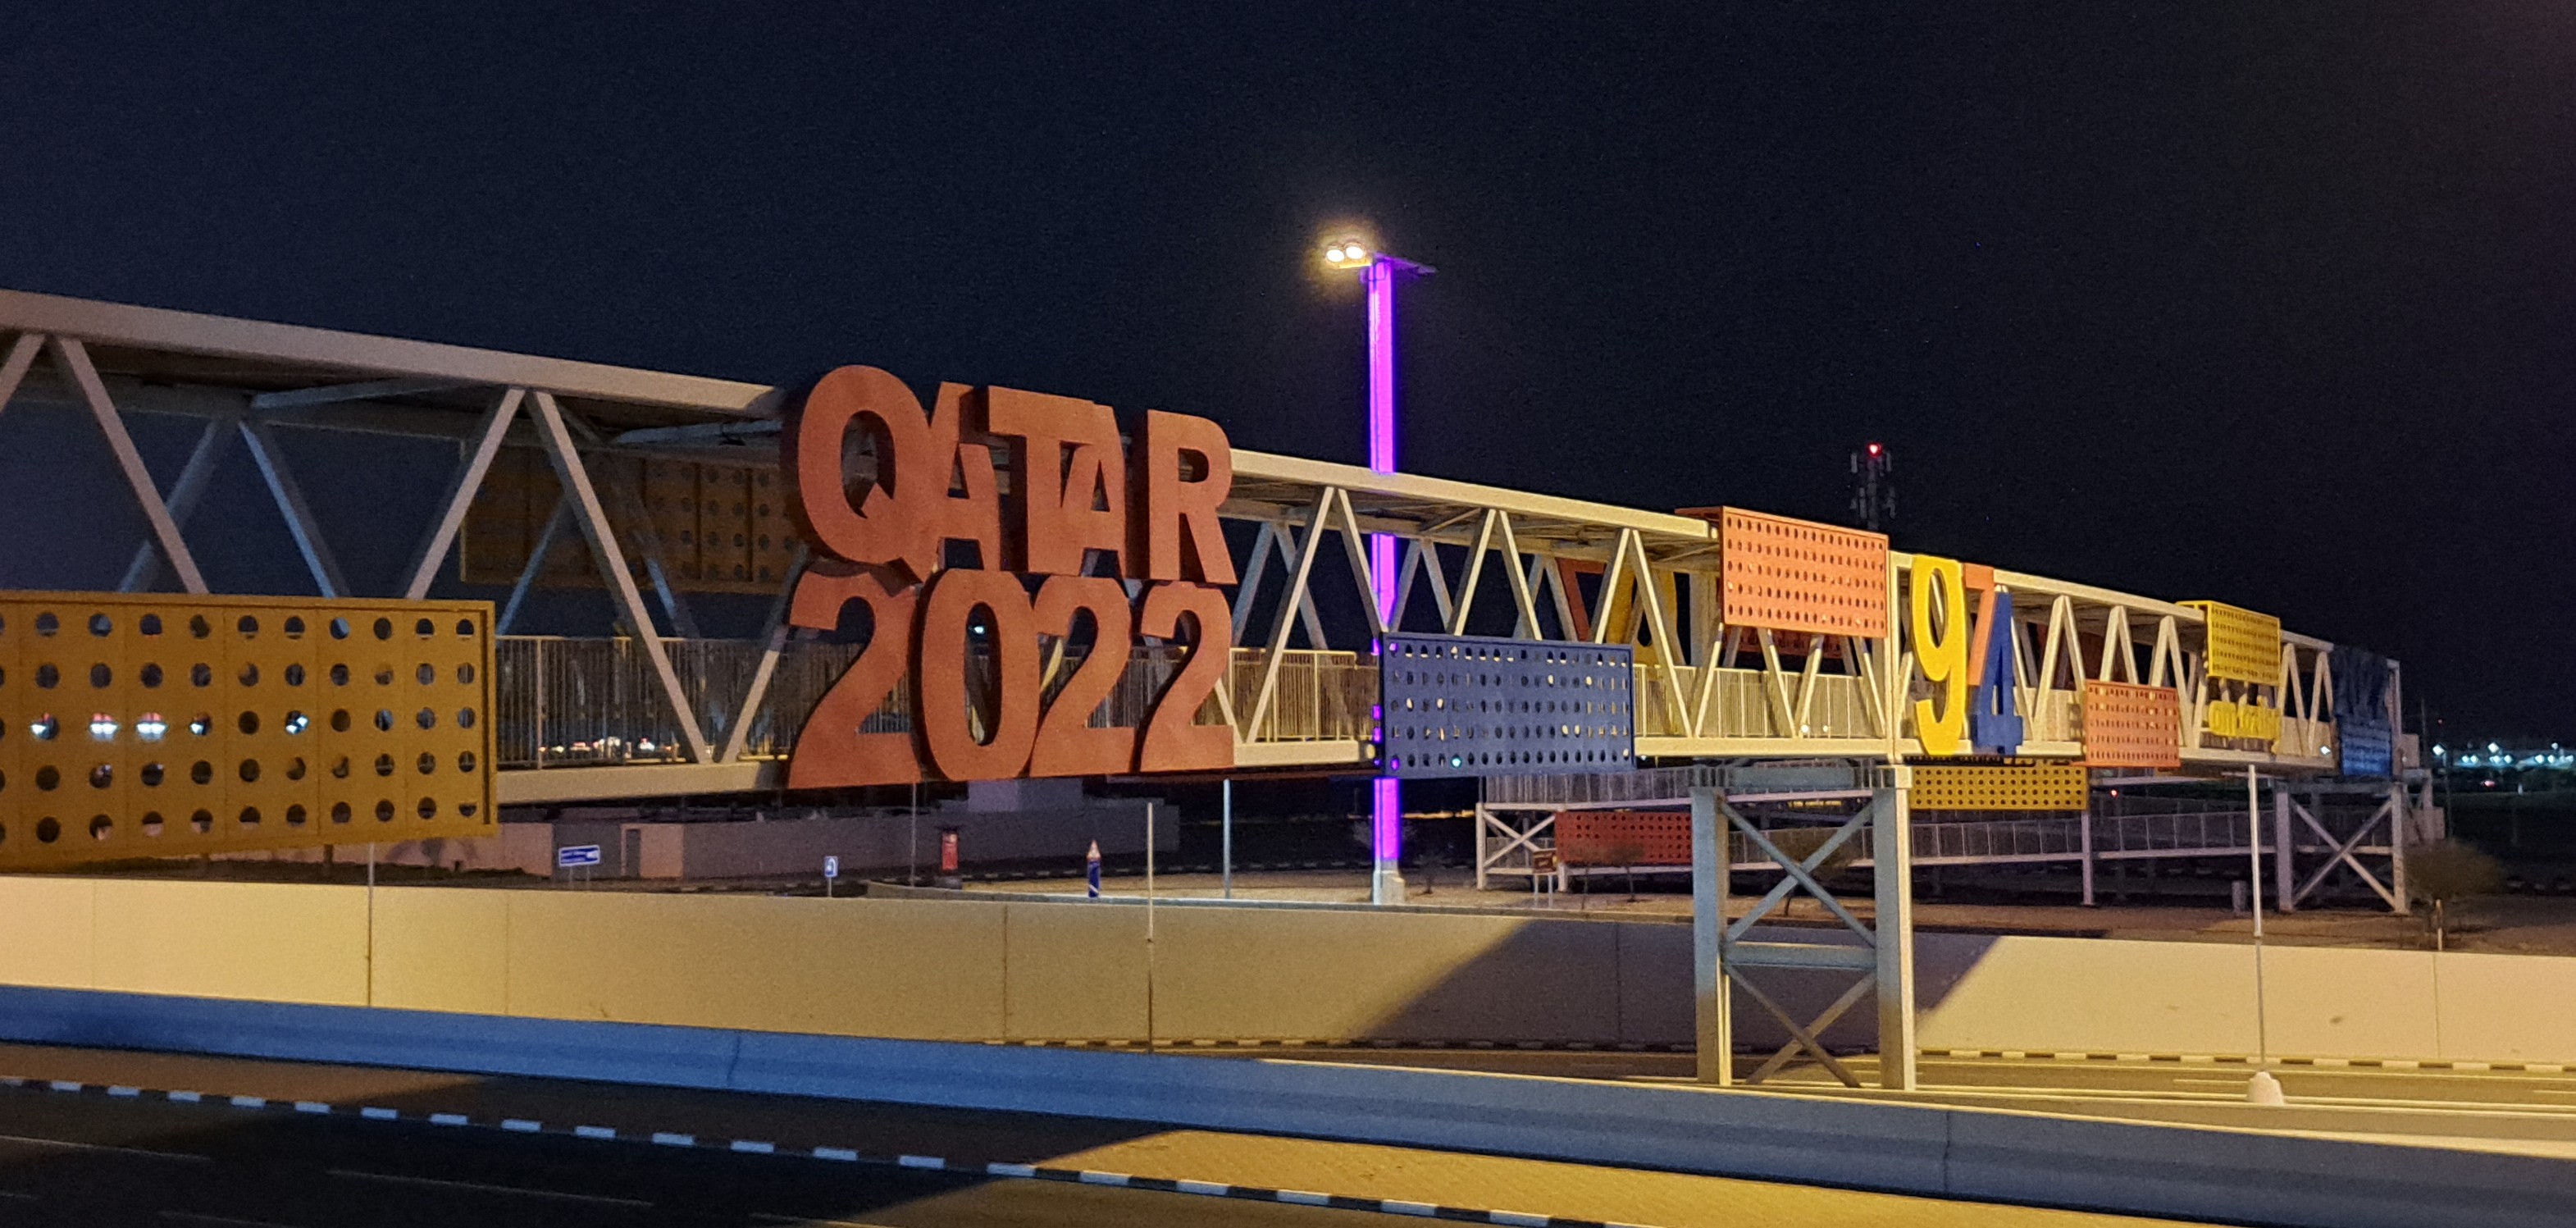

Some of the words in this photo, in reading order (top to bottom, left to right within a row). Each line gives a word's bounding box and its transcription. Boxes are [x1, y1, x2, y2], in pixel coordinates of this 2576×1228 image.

[791, 364, 1238, 586] QATAR
[788, 567, 1235, 789] 2022
[1911, 554, 2023, 756] 974
